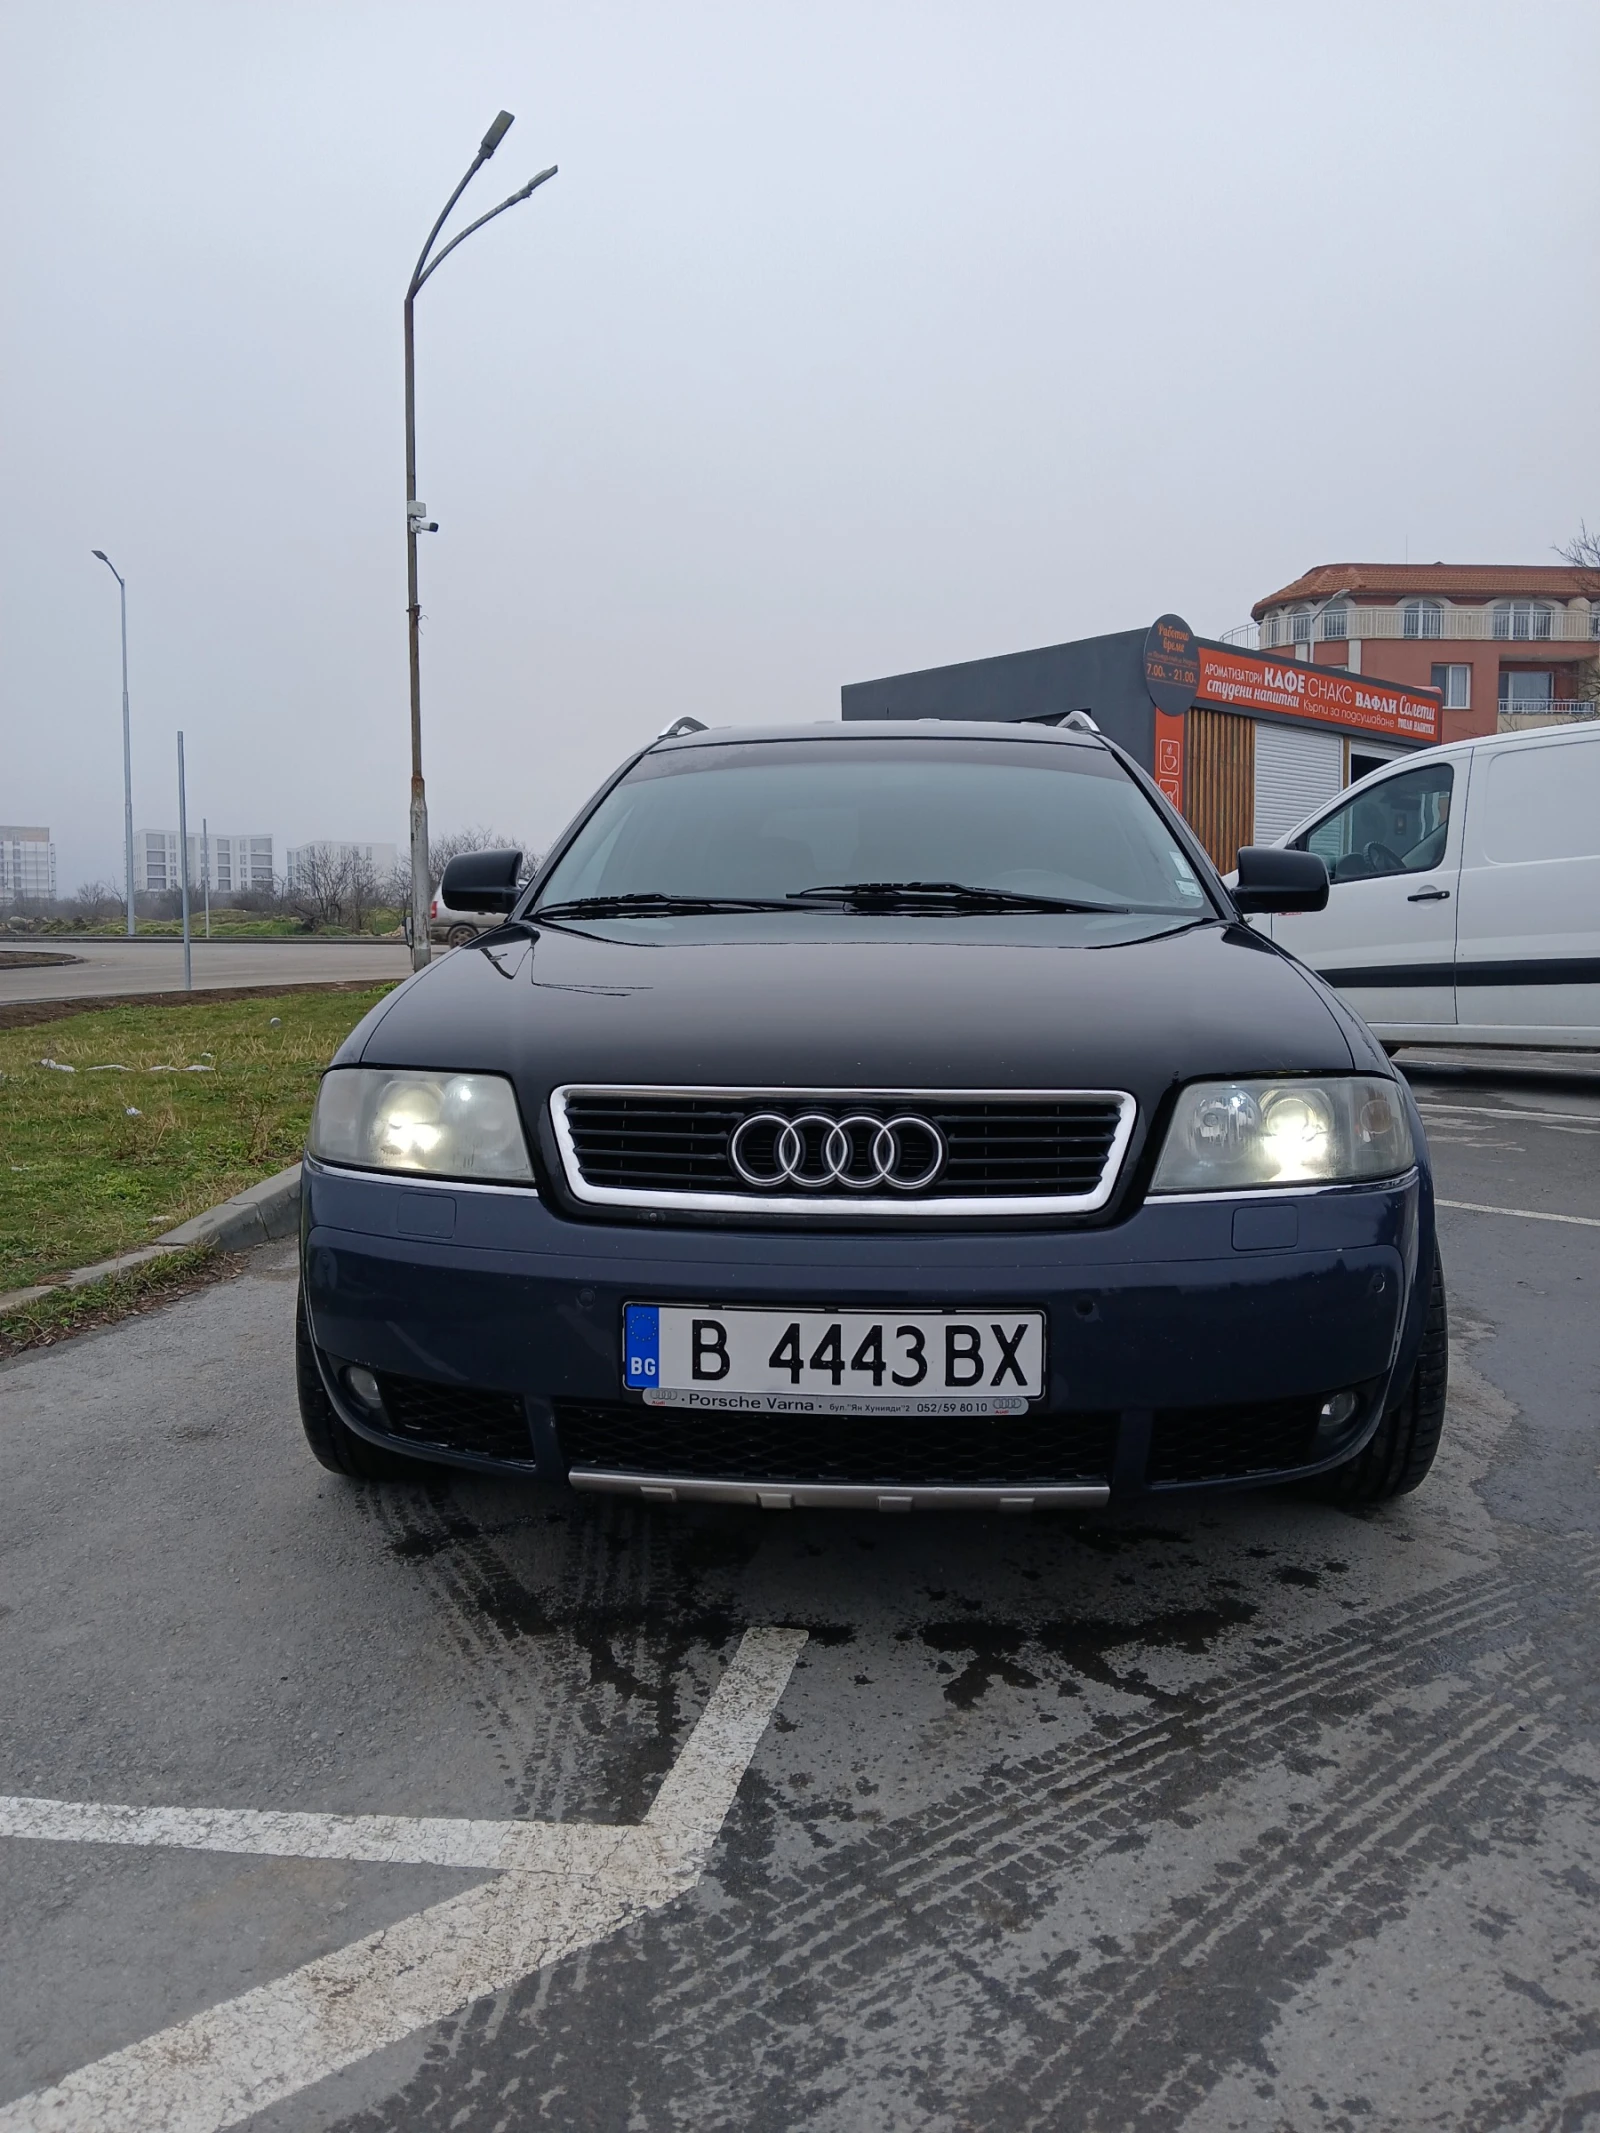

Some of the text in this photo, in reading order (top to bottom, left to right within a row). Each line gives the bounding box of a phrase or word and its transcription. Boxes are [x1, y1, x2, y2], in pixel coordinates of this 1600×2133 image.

[1204, 662, 1263, 684] АРОМАТИЗАТОРИ
[1264, 667, 1306, 693] КАФЕ
[1207, 679, 1300, 708] студени напитки
[1307, 678, 1352, 704] СНАКС
[1355, 691, 1397, 714] ВАФЛИ
[1303, 699, 1395, 728] Кърпи за подсушаване
[1399, 695, 1435, 721] Солети
[691, 1319, 1029, 1387] B 4443 BX
[631, 1357, 656, 1376] BG
[689, 1394, 814, 1411] Porsche Varna
[917, 1403, 956, 1414] 052/59
